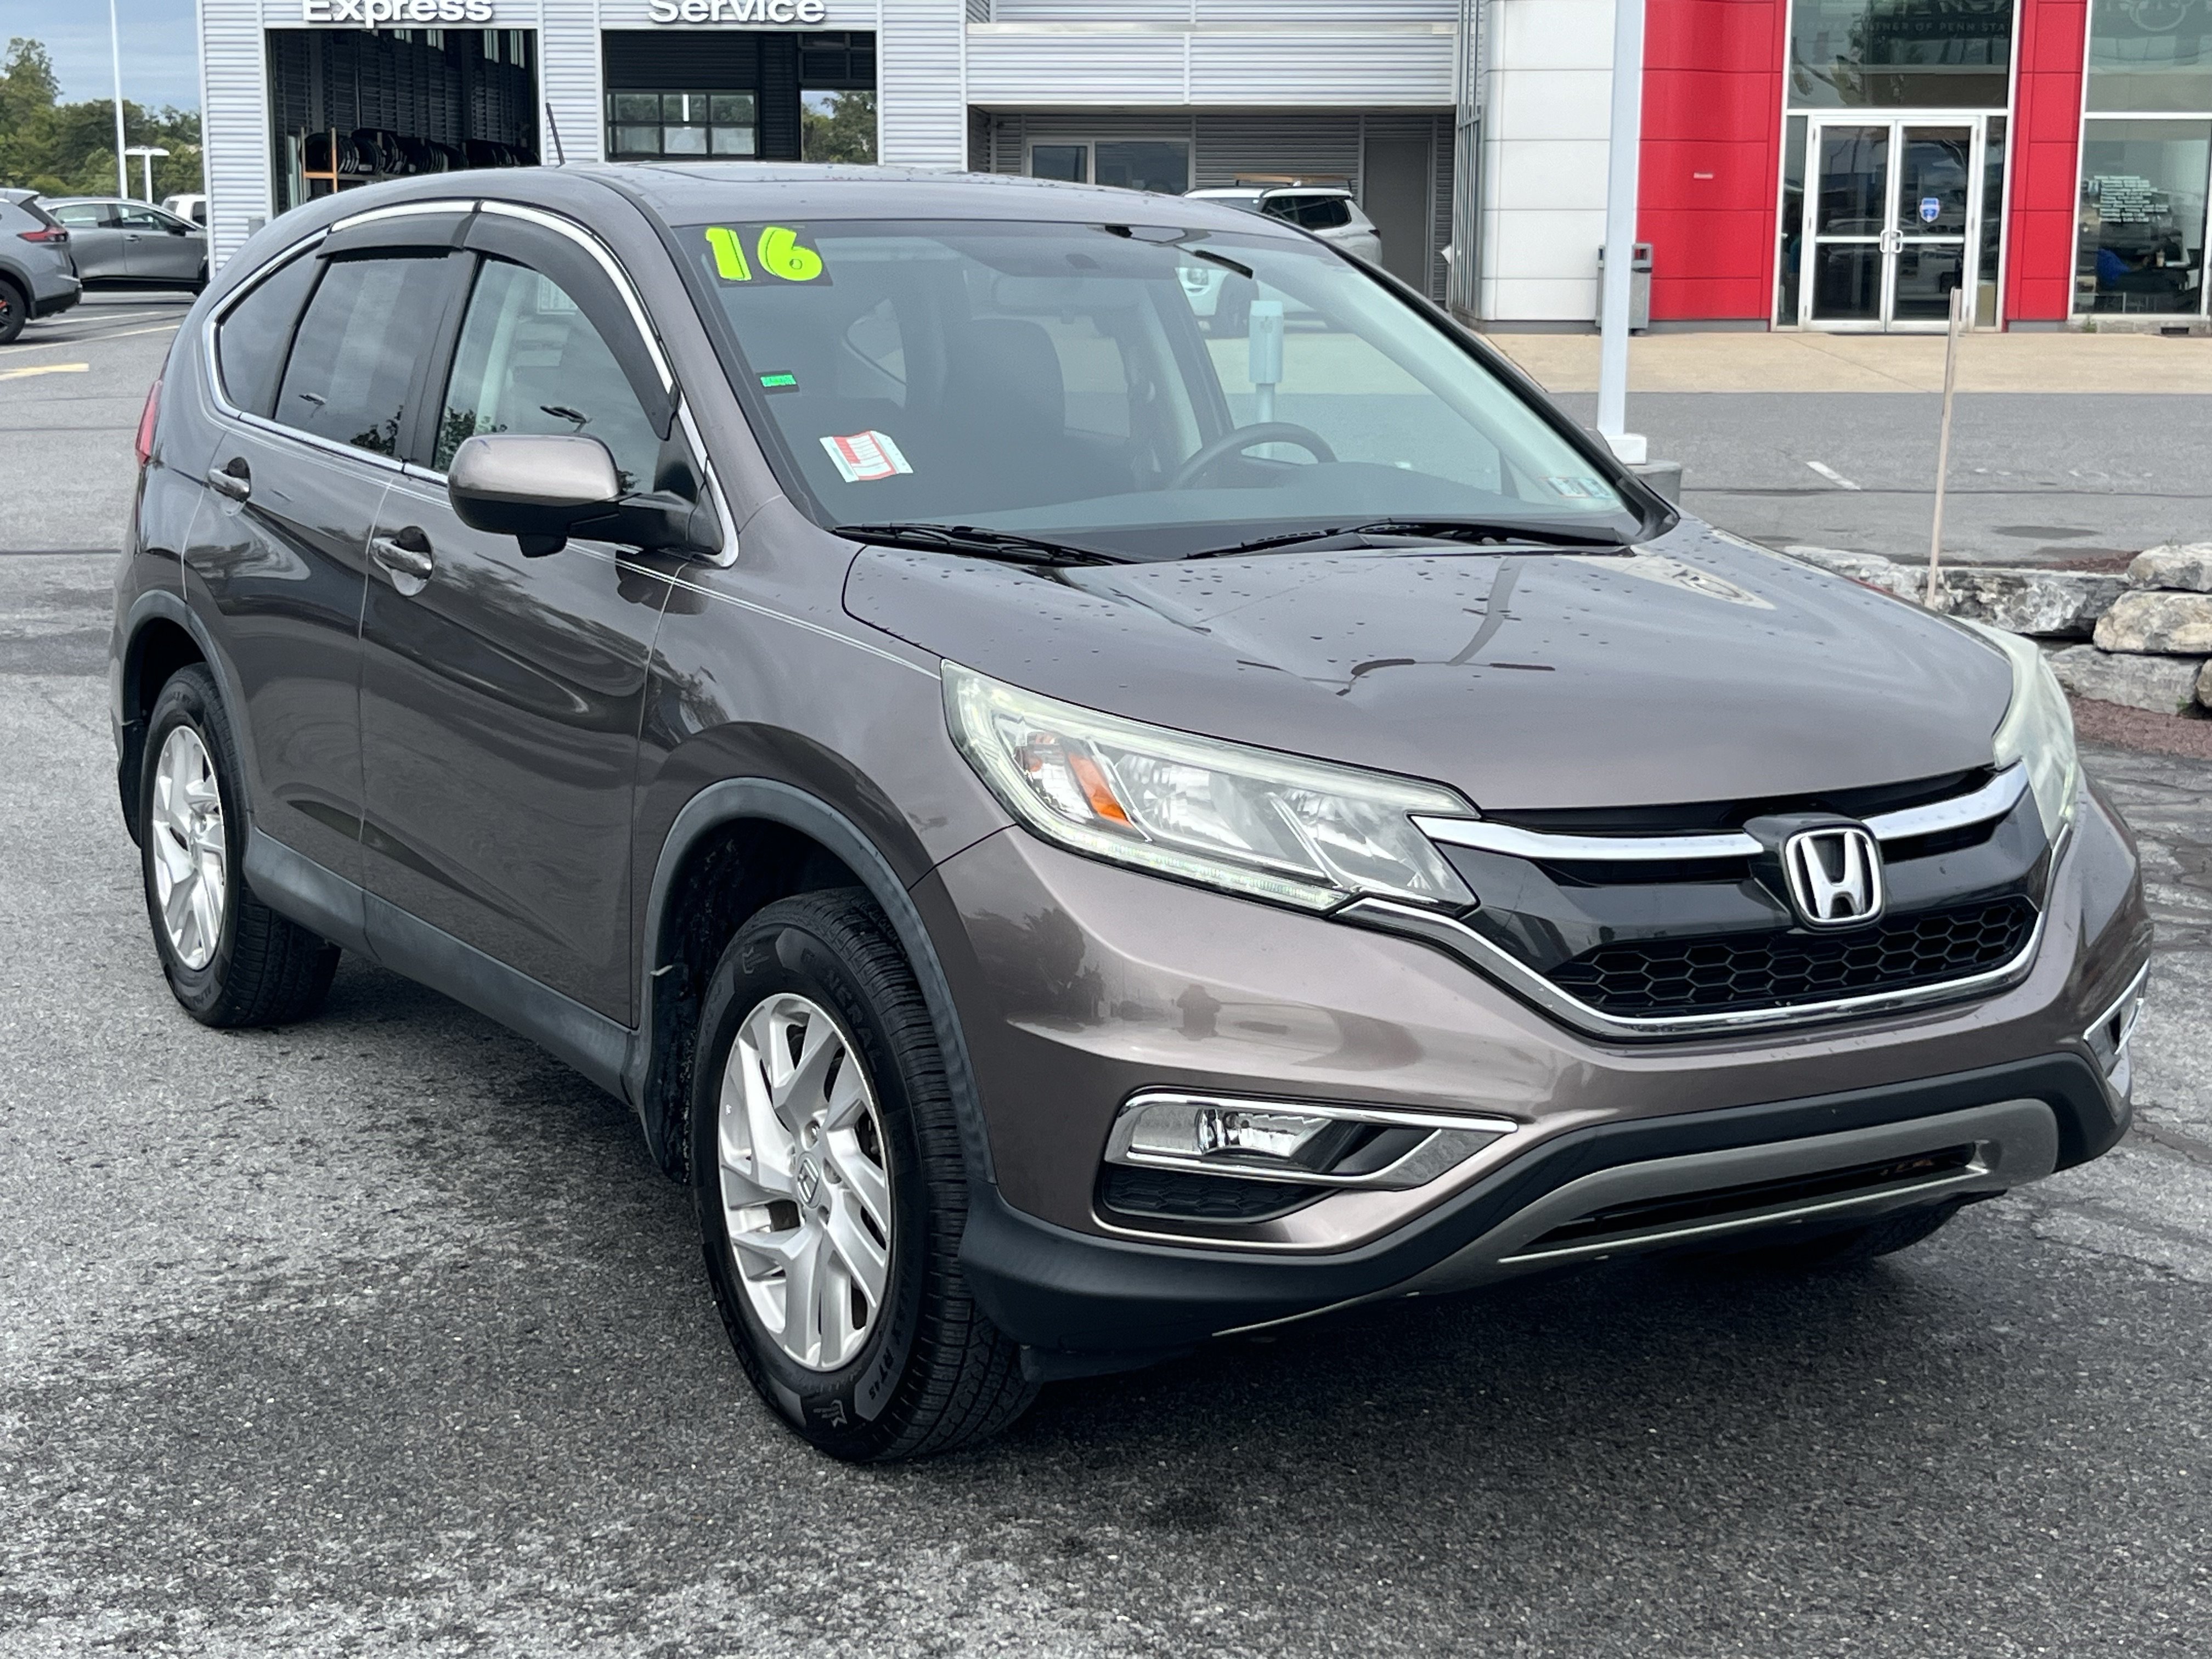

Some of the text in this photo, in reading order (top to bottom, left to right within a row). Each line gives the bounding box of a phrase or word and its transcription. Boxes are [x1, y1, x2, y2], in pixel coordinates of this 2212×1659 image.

[303, 0, 493, 29] Express
[648, 0, 825, 22] Service
[1915, 21, 1933, 31] OF
[1939, 21, 1975, 32] PENN
[706, 226, 823, 281] 16
